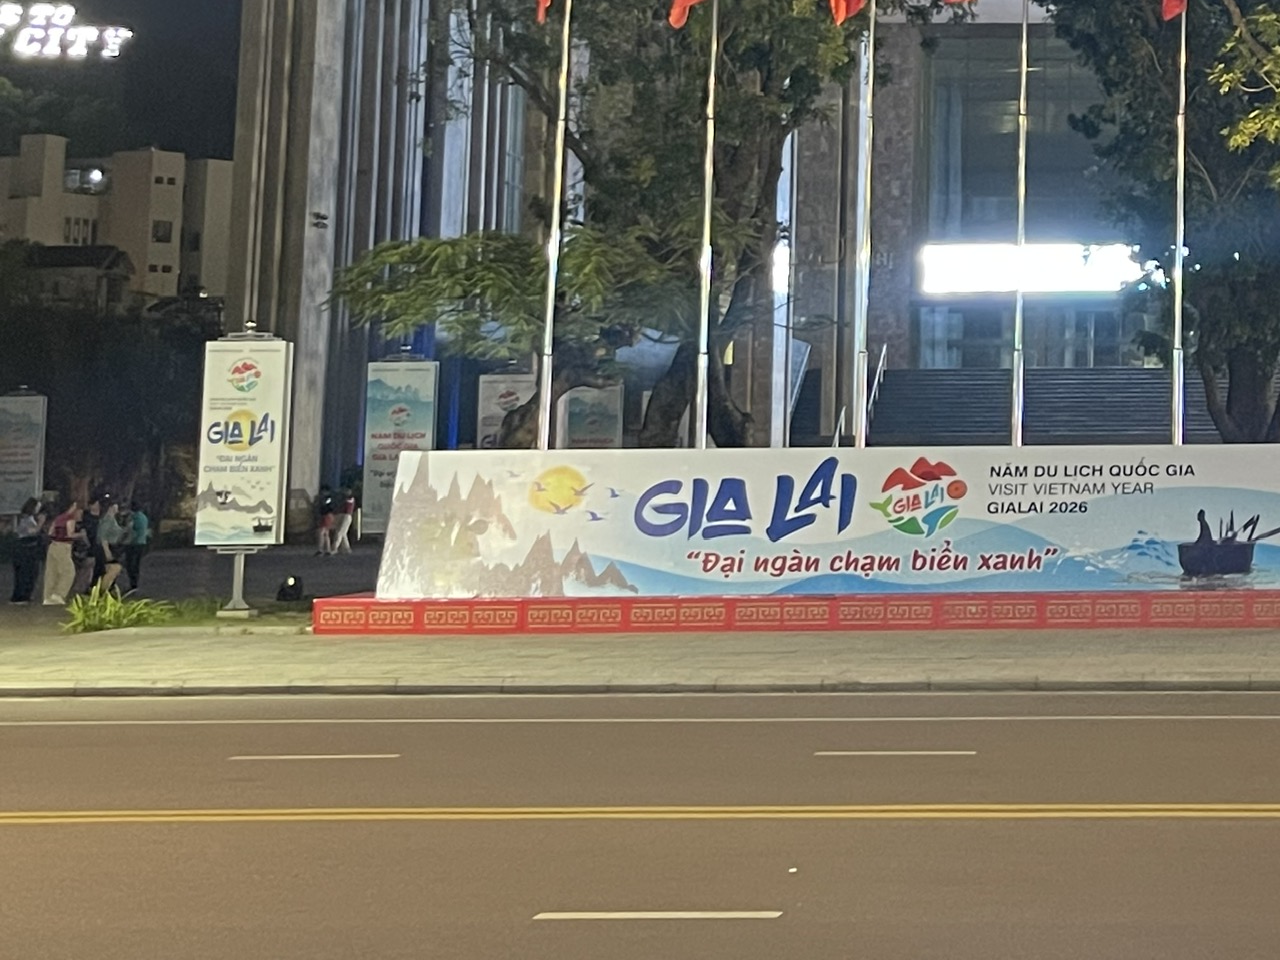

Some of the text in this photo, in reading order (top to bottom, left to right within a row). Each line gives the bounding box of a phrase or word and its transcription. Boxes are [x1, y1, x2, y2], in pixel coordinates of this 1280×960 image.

[14, 26, 134, 57] CITY
[207, 412, 275, 447] GIA LAI
[990, 456, 1195, 480] NĂM DU LỊCH QUỐC GIA
[634, 456, 857, 543] GIA LAI
[893, 483, 945, 514] GIA LAI
[988, 482, 1154, 495] VISIT VIETNAM YEAR
[987, 501, 1088, 514] GIALAI 2026
[754, 549, 820, 577] ngàn
[829, 550, 900, 577] chạm
[911, 540, 969, 571] biển
